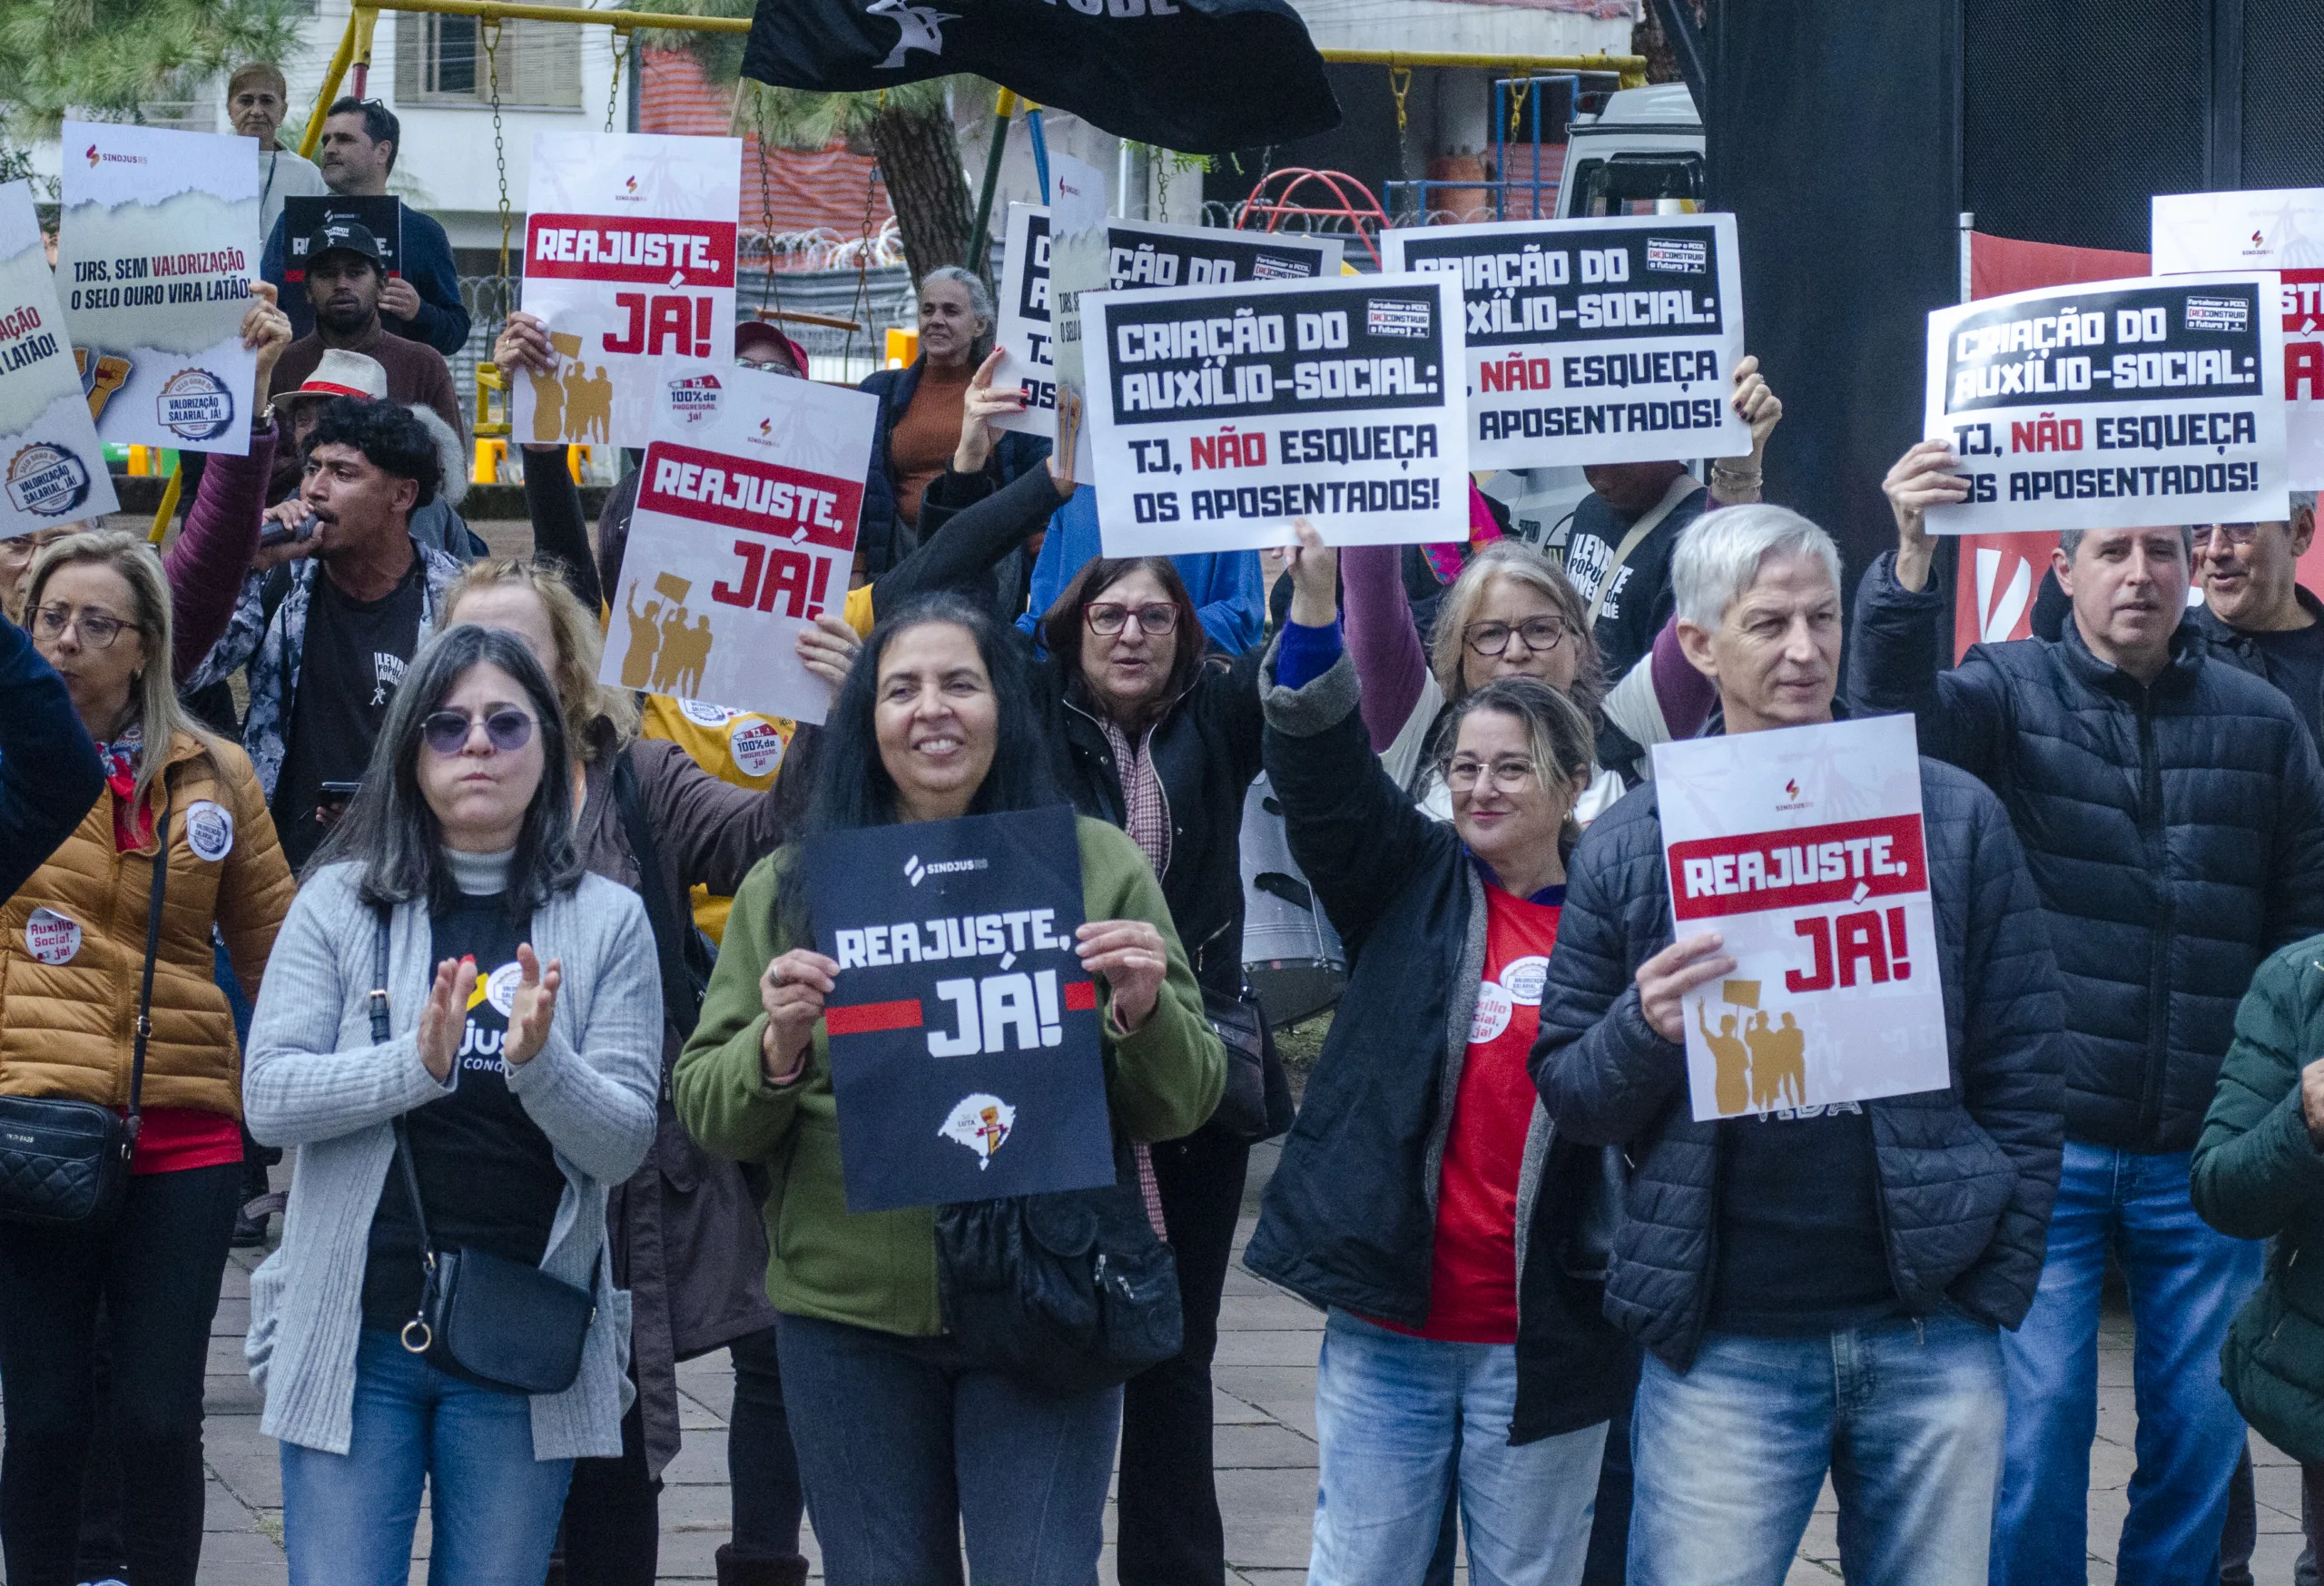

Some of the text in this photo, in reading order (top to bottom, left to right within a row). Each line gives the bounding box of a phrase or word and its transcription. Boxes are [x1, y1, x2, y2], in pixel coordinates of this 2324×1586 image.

[74, 247, 245, 282] TJRS, SEM VALORIZAÇÃO
[536, 228, 720, 272] REAJUSTE,
[1188, 257, 1236, 285] DO
[1581, 248, 1629, 284] DO
[71, 275, 253, 310] O SELO OURO VIRA LATÃO!
[1464, 280, 1717, 334] XÍLIO-SOCIAL:
[602, 271, 714, 359] JÁ!
[1956, 307, 2166, 363] CRIAÇÃO DO
[2, 332, 59, 373] LATÃO!
[1117, 307, 1285, 368] CRIAÇÃO
[1296, 310, 1349, 352] DO
[1122, 357, 1438, 412] AUXÍLIO-SOCIAL:
[1481, 350, 1718, 393] NÃO ESQUEÇA
[1954, 350, 2256, 404] AUXÍLIO-SOCIAL:
[169, 396, 219, 410] VALORIZAÇÃO
[169, 408, 222, 422] SALARIAL, JÁ!
[671, 390, 716, 402] 100% de
[1479, 399, 1722, 441] APOSENTADOS!
[1954, 410, 2256, 458] TJ, NÃO ESQUEÇA
[1128, 423, 1439, 476] TJ, NÃO ESQUEÇA
[18, 464, 70, 492] VALORIZAÇÃO
[23, 482, 64, 505] SALARIAL,
[653, 458, 842, 534] REAJUSTE,
[1957, 462, 2259, 505] OS APOSENTADOS!
[1133, 478, 1440, 524] OS APOSENTADOS!
[711, 525, 832, 622] JÁ!
[737, 738, 775, 753] 100% de
[926, 858, 988, 874] SINDJUSRS
[1683, 835, 1907, 900] REAJUSTE,
[835, 908, 1070, 970] REAJUSTE,
[1785, 882, 1911, 994] JÁ!
[927, 951, 1063, 1058] JÁ!
